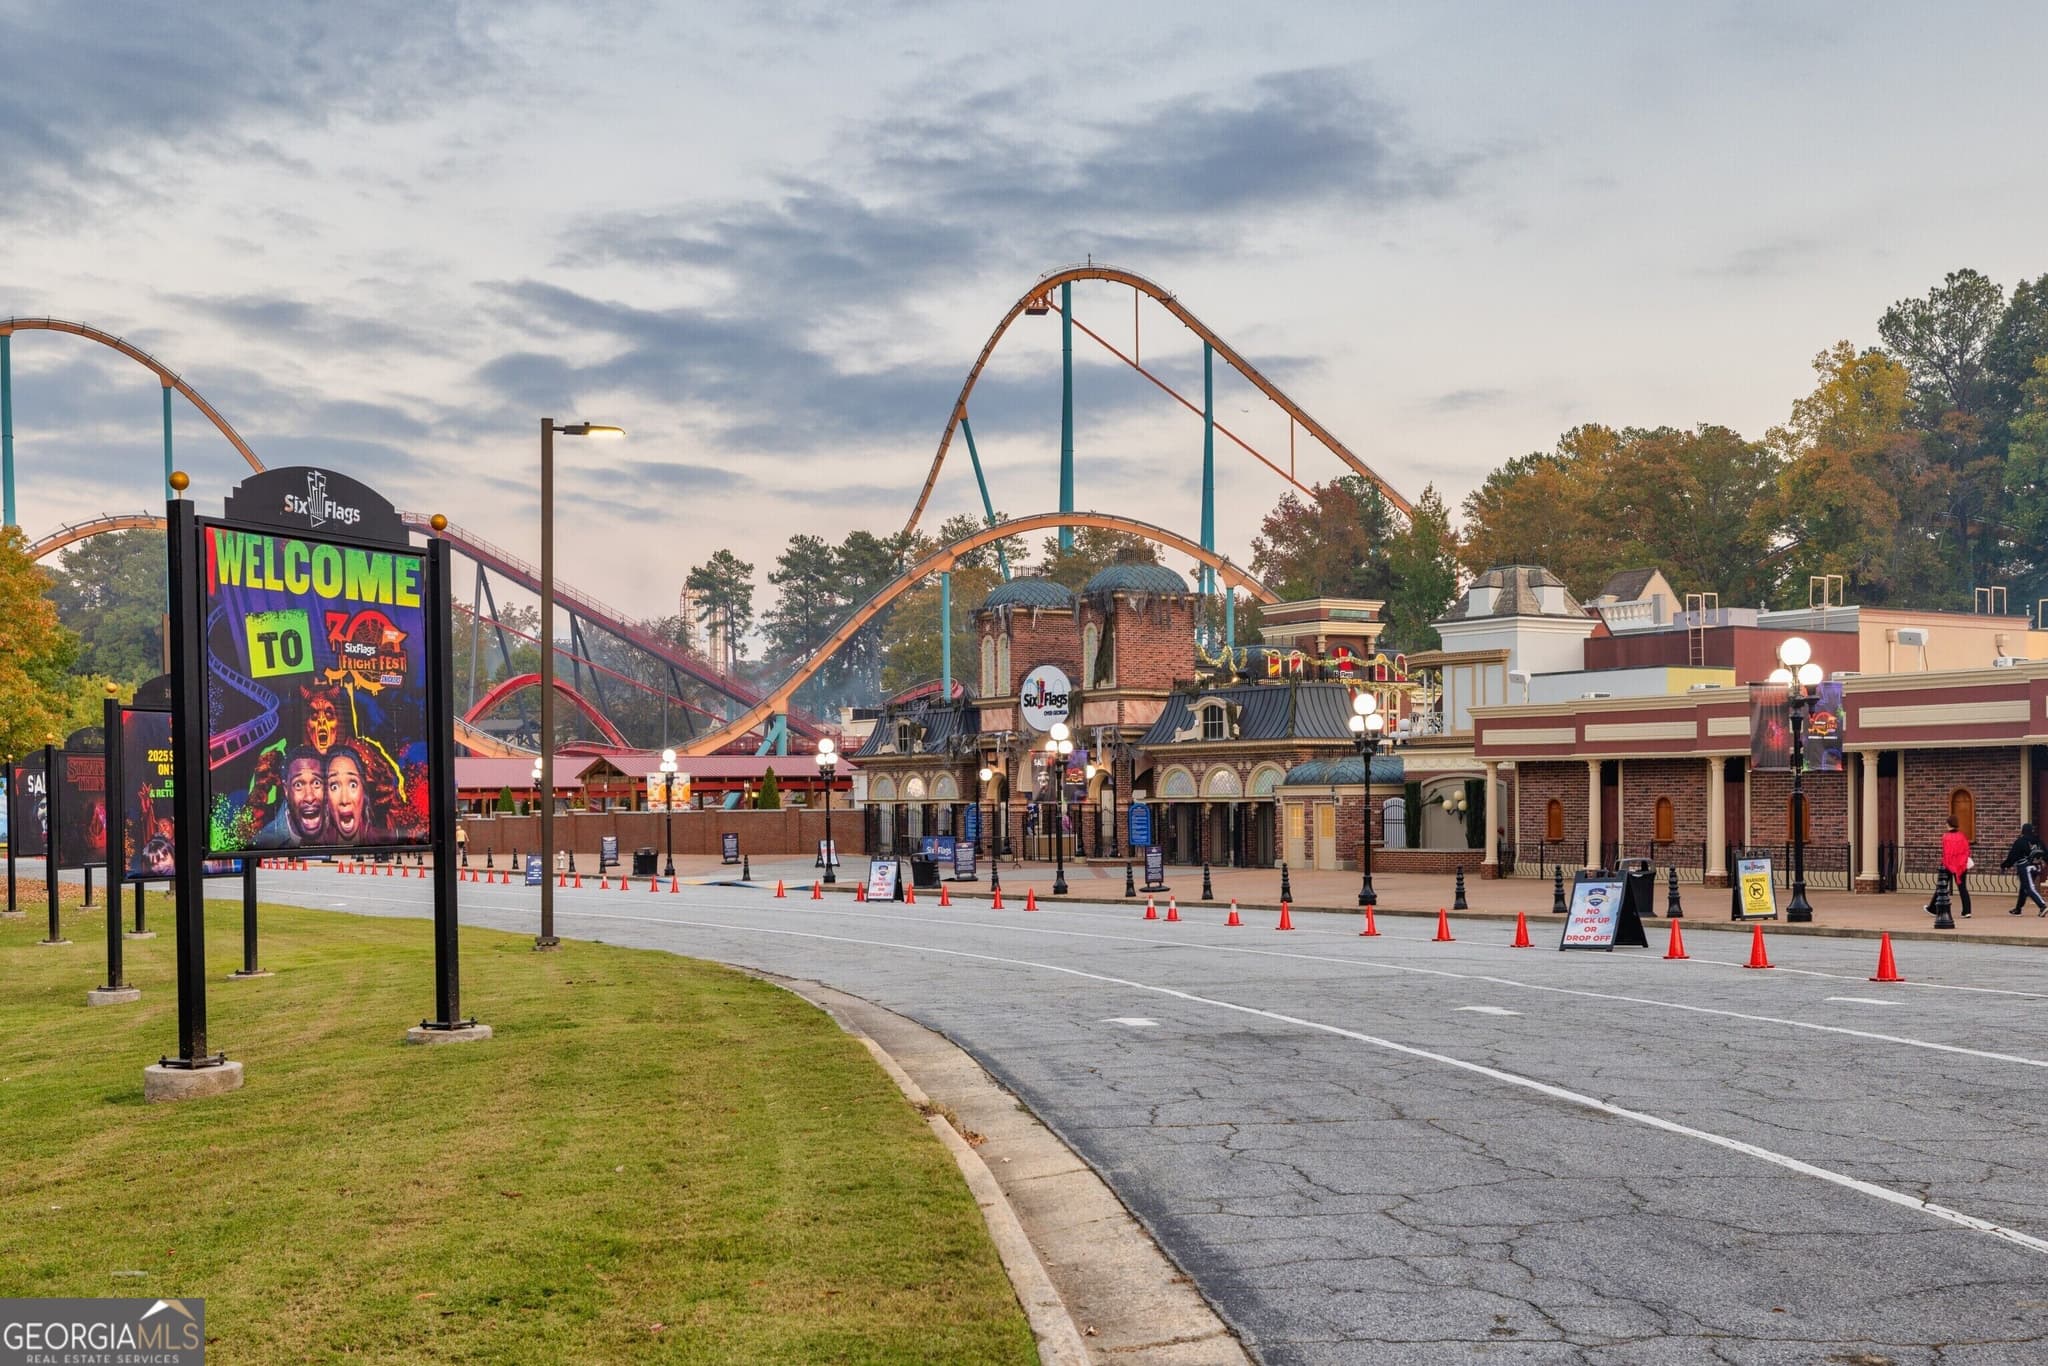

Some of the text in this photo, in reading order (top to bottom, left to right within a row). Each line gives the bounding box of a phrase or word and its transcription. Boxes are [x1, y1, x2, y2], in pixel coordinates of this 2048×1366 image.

[284, 494, 360, 525] Six Flags
[215, 529, 420, 608] WELCOME
[257, 629, 304, 669] TO
[345, 642, 376, 656] SixFlags
[380, 655, 405, 671] FEST
[1023, 691, 1068, 708] Six Flags
[148, 749, 169, 762] 2025
[158, 764, 170, 776] ON
